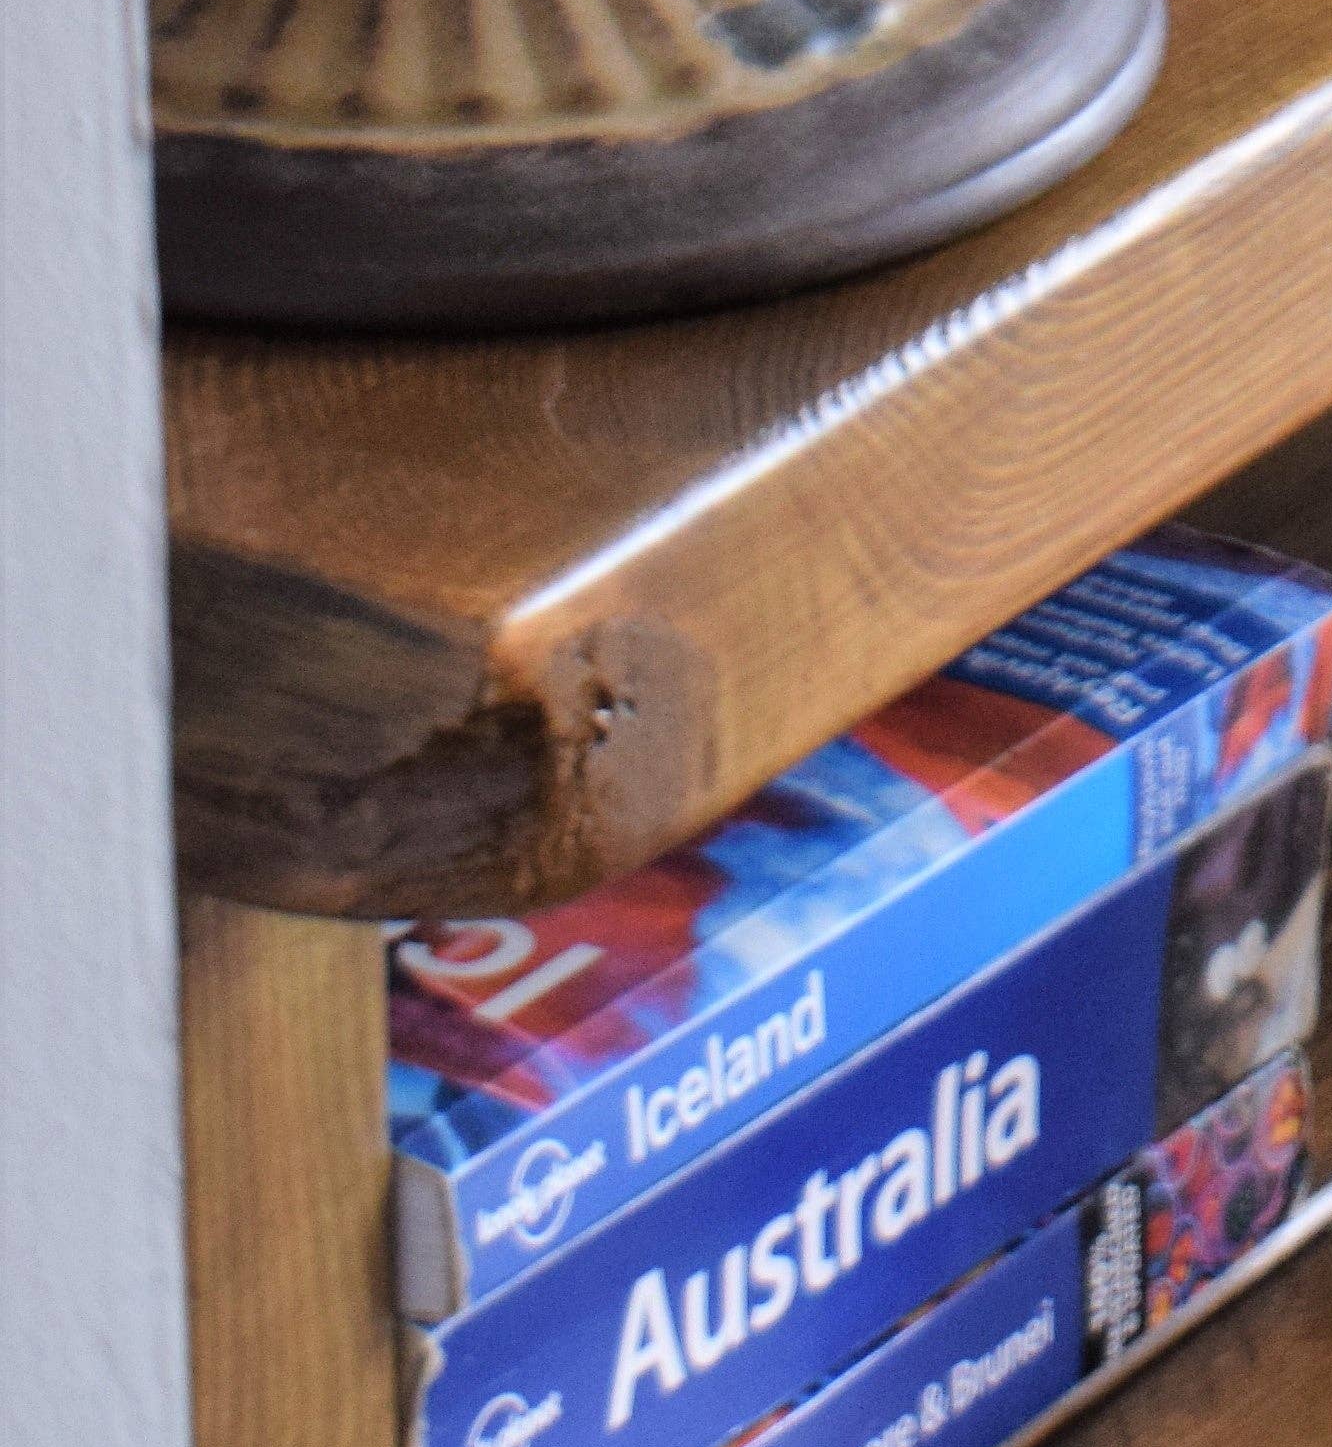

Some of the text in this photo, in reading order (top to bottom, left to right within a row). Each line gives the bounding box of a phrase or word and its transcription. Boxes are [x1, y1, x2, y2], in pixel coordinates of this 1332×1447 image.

[626, 969, 828, 1163] Iceland
[604, 1050, 1042, 1431] Australia
[919, 1384, 948, 1434] &
[948, 1296, 1056, 1414] Brunei
